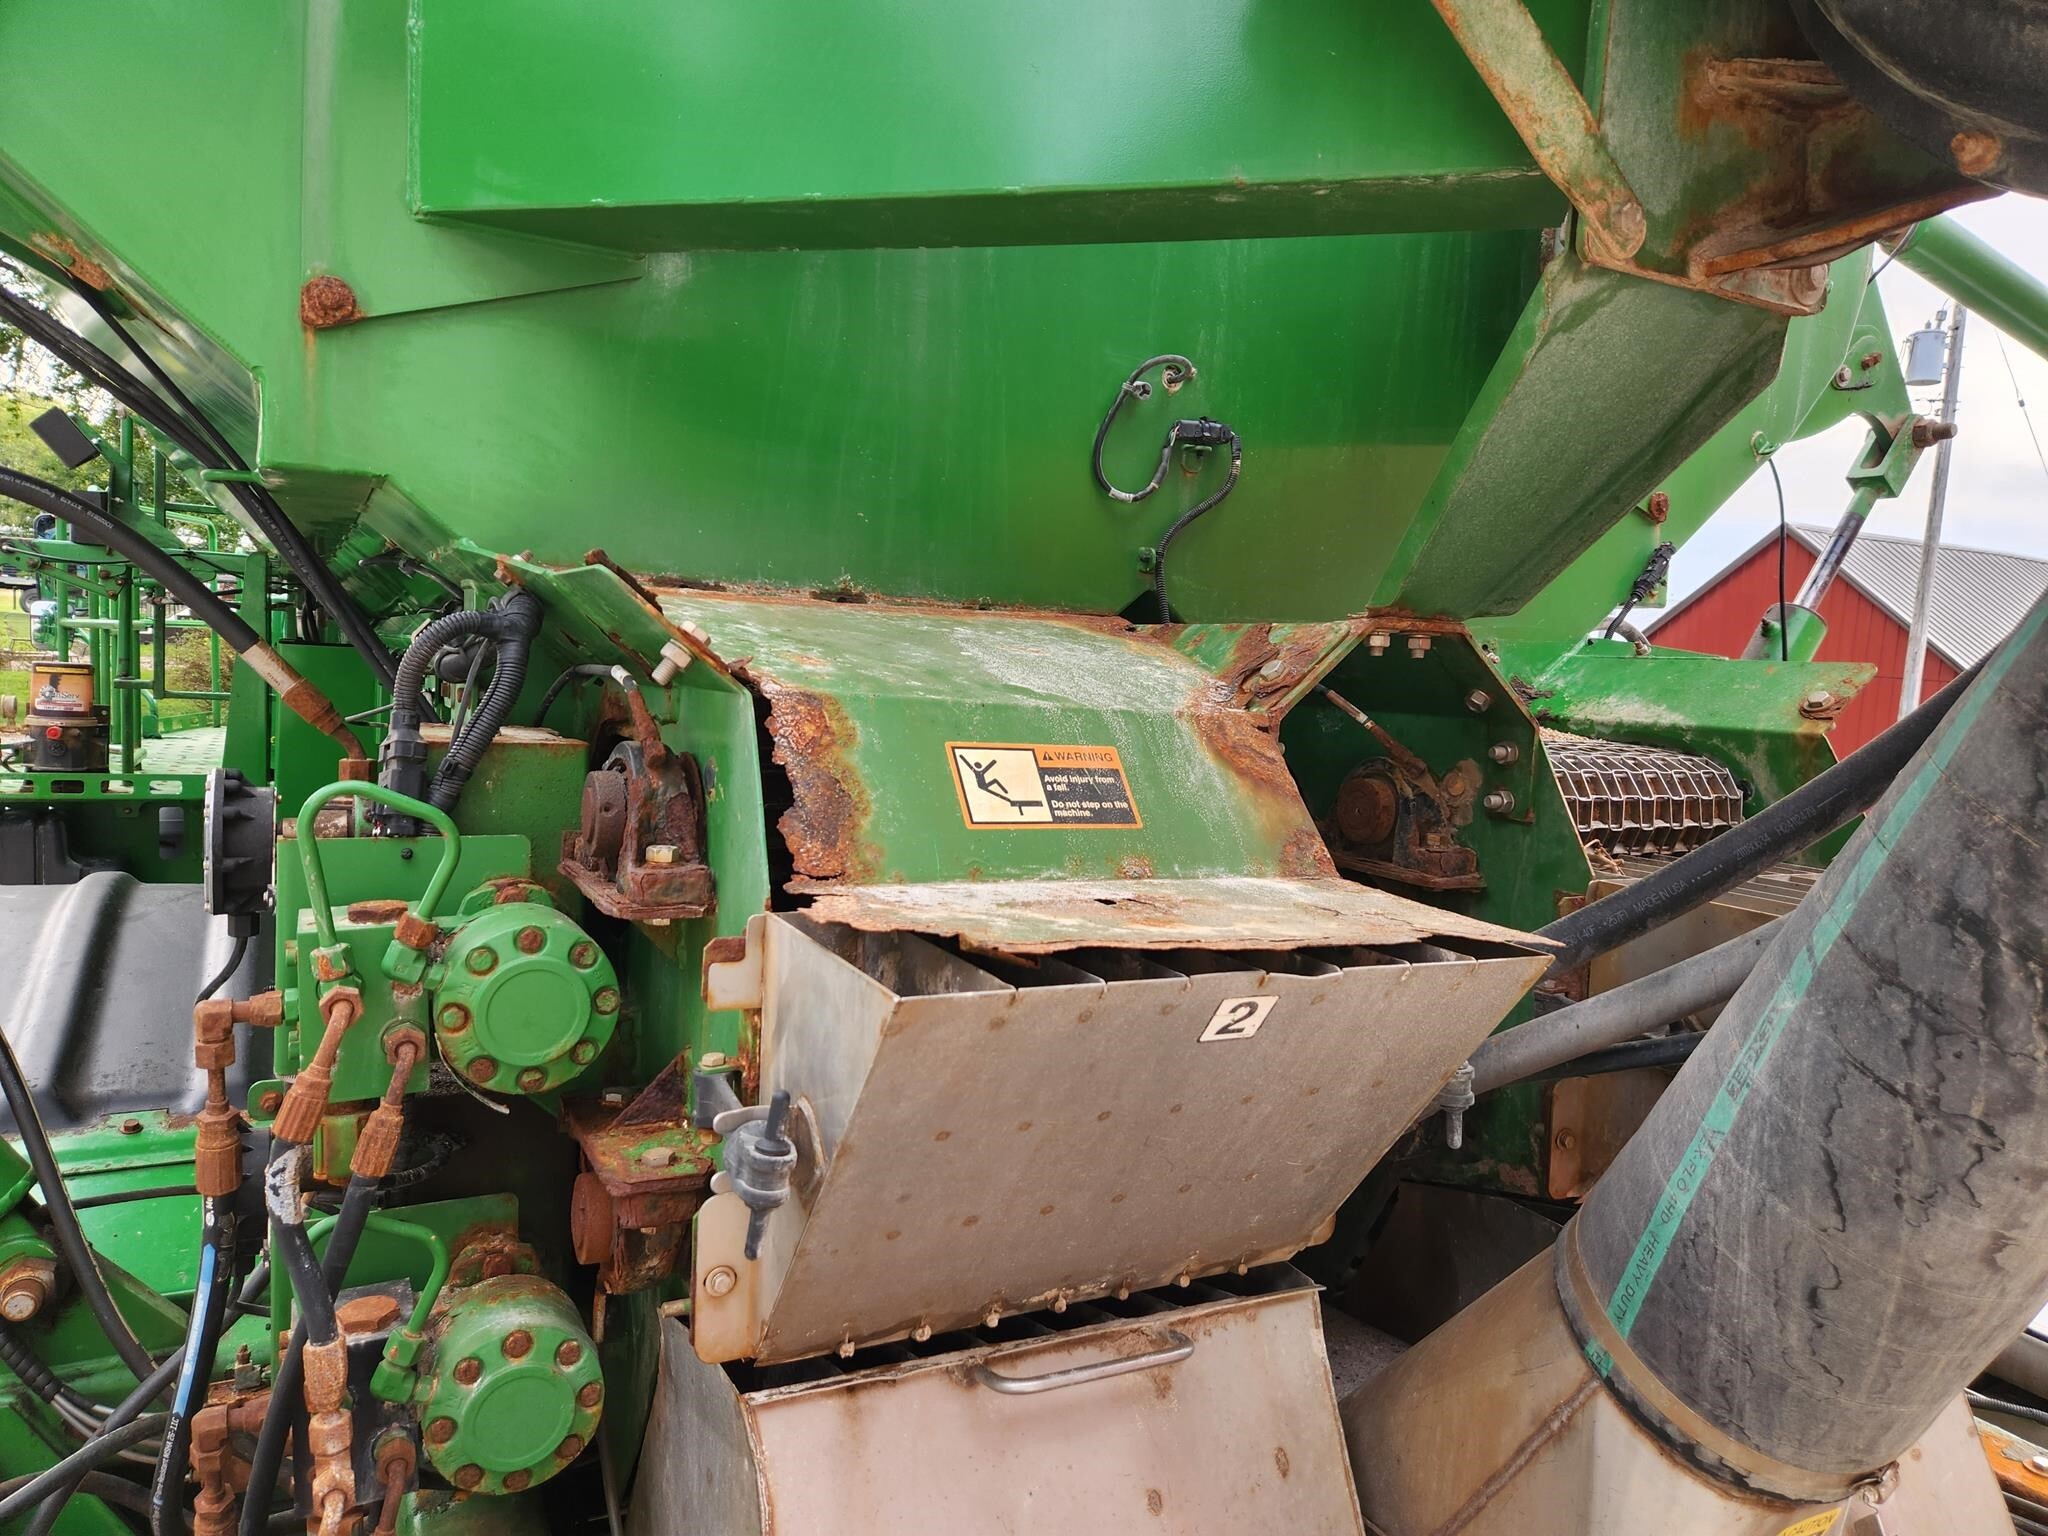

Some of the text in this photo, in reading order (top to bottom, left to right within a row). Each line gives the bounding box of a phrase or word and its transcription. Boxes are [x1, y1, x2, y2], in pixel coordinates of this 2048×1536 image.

[1054, 752, 1113, 762] WARNING
[1044, 775, 1115, 785] Avoid injury from
[1053, 783, 1070, 791] fall.
[1051, 800, 1064, 809] Do
[1065, 801, 1080, 809] not
[1081, 801, 1100, 810] step
[1114, 801, 1129, 809] the
[1054, 809, 1094, 817] machine.
[1632, 896, 1658, 914] MADE
[1670, 879, 1688, 896] USA
[1215, 1001, 1259, 1035] 2
[1632, 1230, 1660, 1287] HEAVY
[1613, 1283, 1636, 1325] DUTY
[163, 1440, 174, 1459] MSHA
